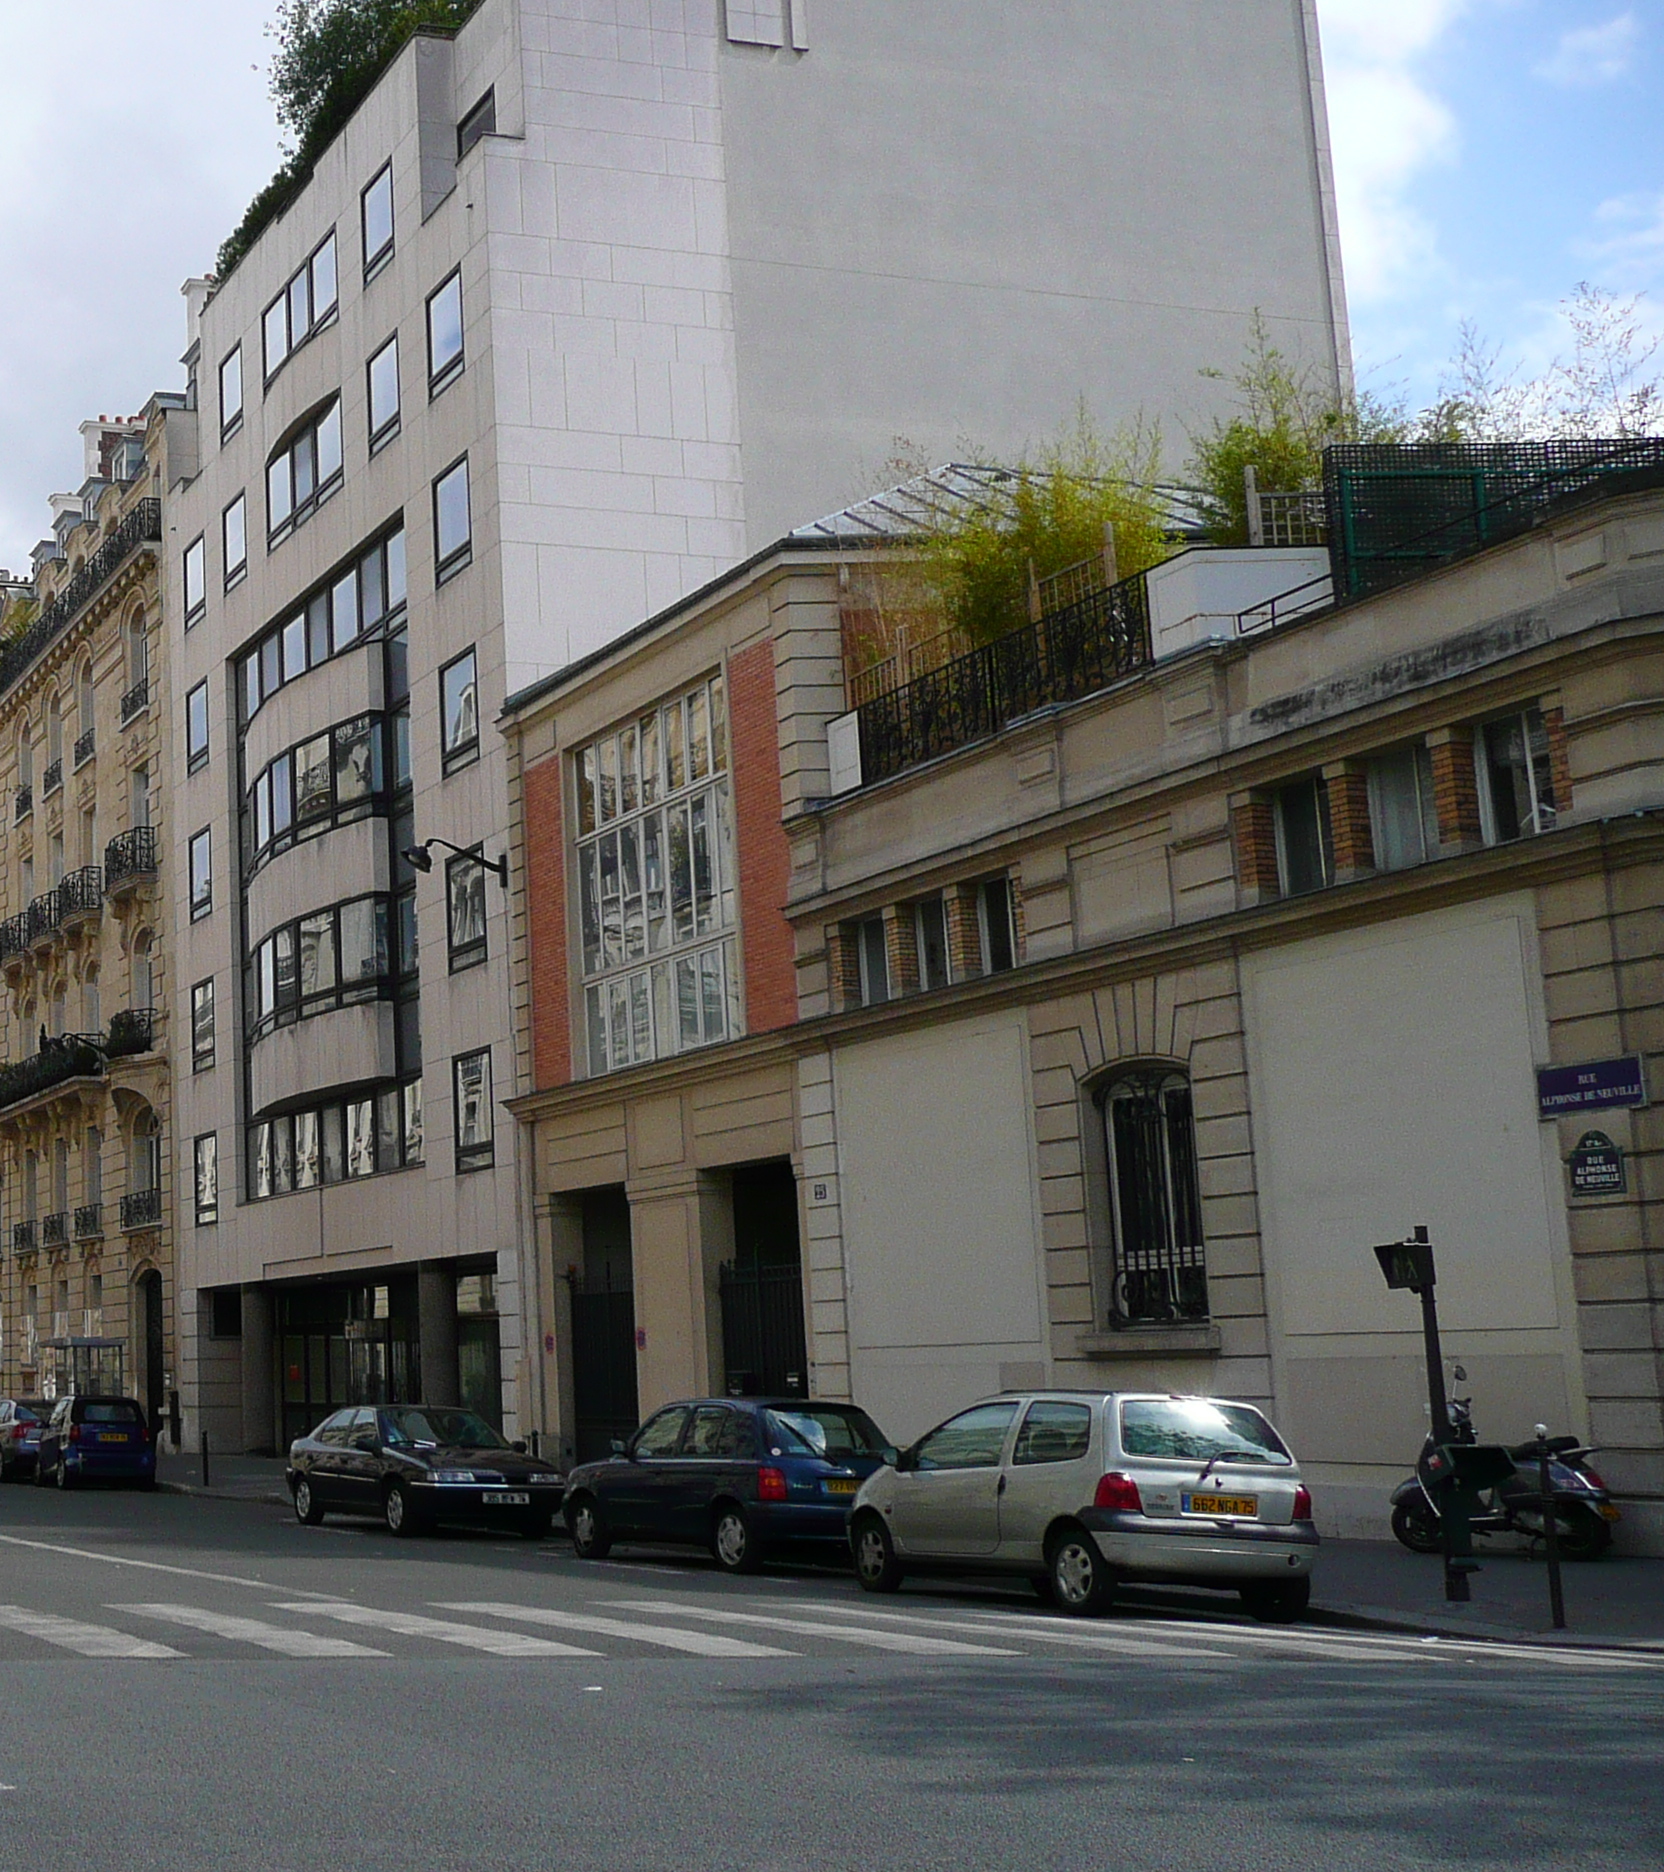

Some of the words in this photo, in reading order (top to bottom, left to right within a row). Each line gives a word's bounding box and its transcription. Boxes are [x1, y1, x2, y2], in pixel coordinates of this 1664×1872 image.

[1578, 1073, 1597, 1085] RUE
[1541, 1092, 1582, 1106] ALPHONSE
[1584, 1090, 1595, 1101] DE
[1597, 1084, 1641, 1099] NEUVILLE
[1587, 1155, 1604, 1164] RUE
[1577, 1163, 1616, 1174] ALPHONSE
[1575, 1176, 1585, 1184] DE
[1586, 1173, 1620, 1183] NEUVILLE
[1193, 1497, 1216, 1512] 662
[1218, 1499, 1239, 1513] NGA
[1241, 1500, 1254, 1514] 75
